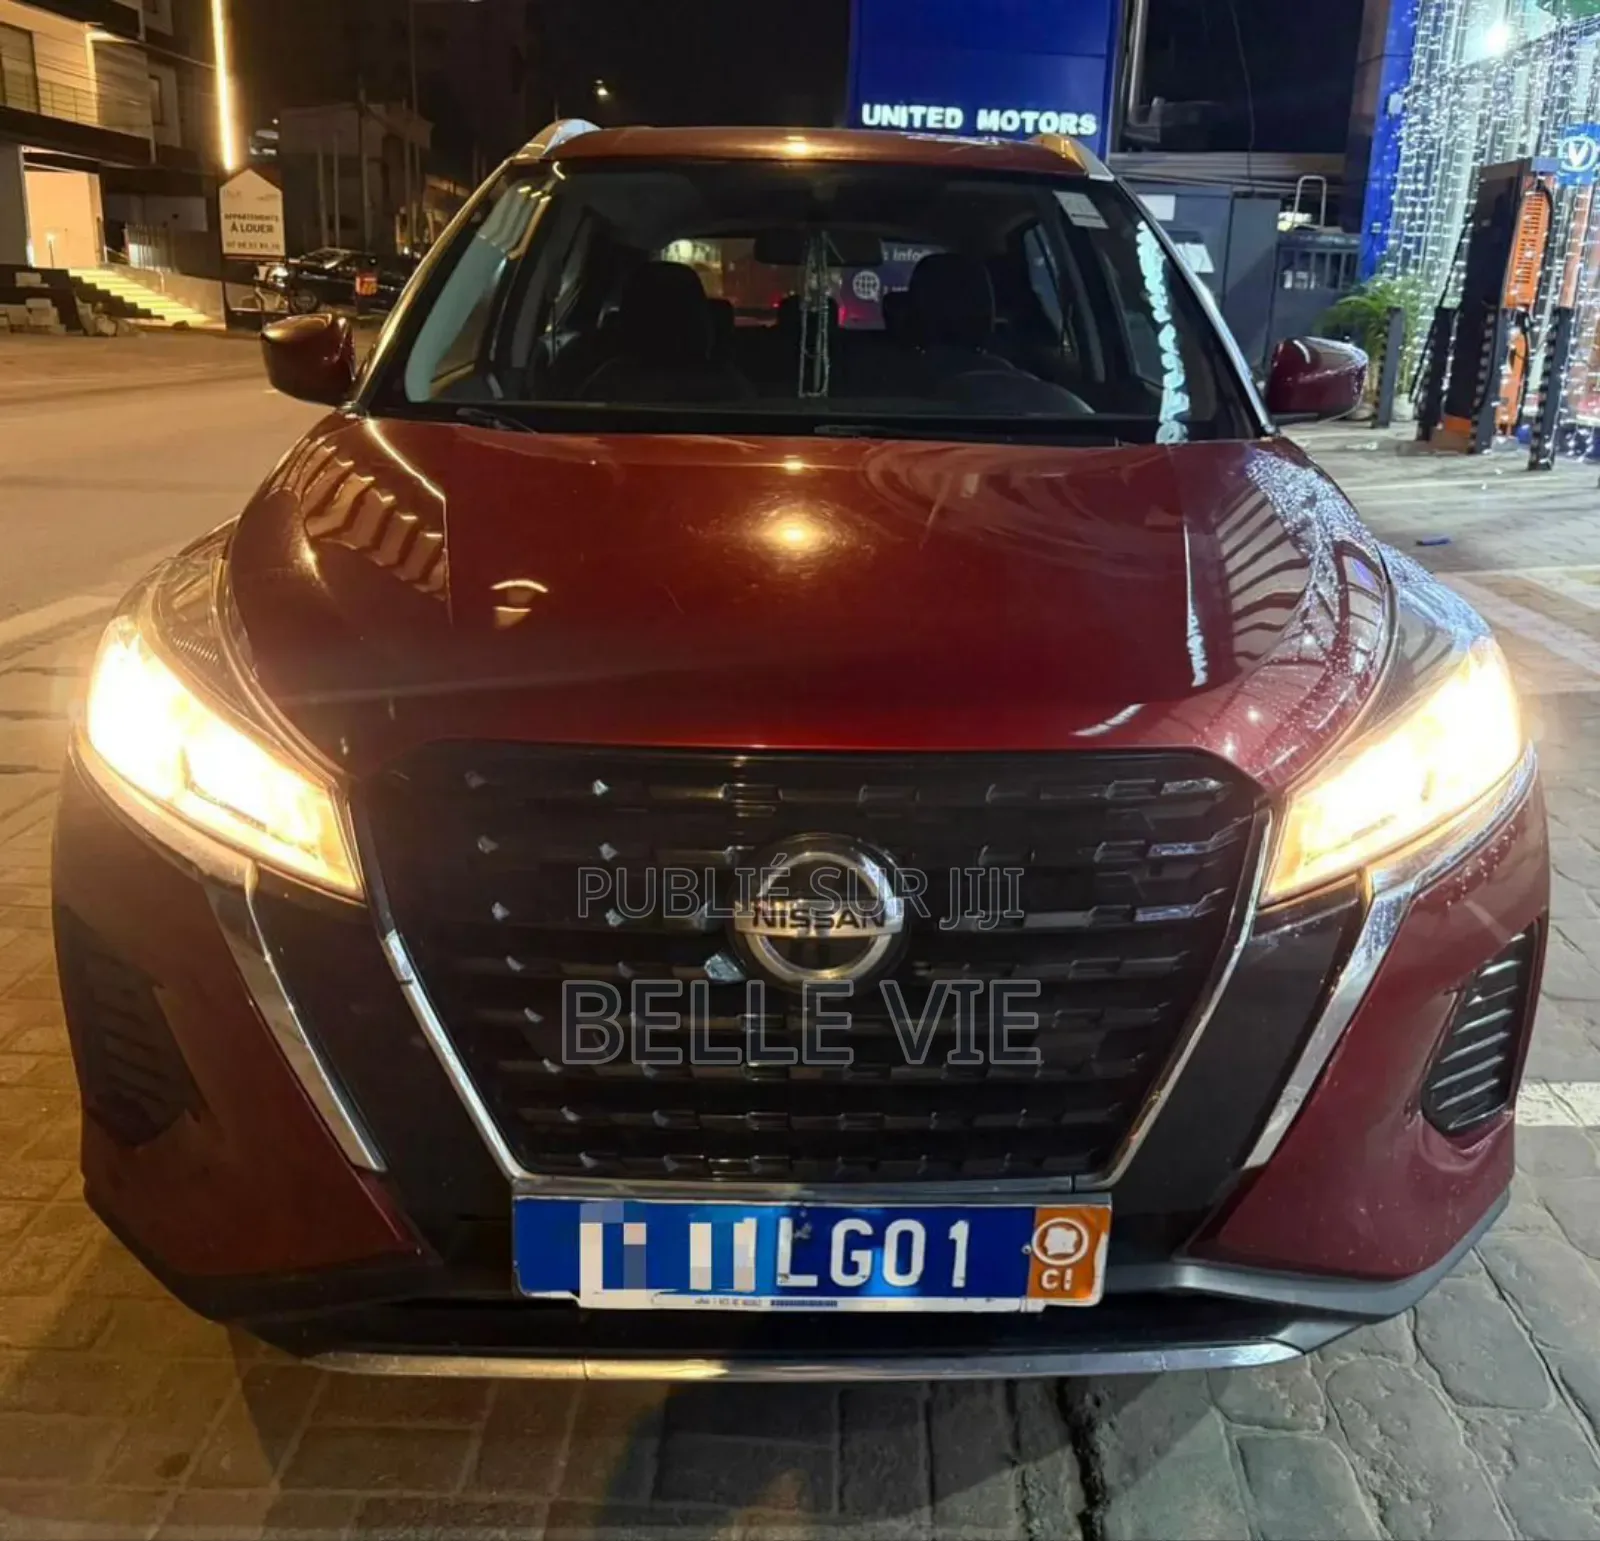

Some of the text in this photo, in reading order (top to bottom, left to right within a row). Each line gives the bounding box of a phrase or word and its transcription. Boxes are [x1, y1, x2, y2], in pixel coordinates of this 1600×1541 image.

[862, 103, 1097, 135] UNITED MOTORS
[240, 223, 274, 233] LOUER
[752, 901, 886, 930] NISSAN
[1041, 1267, 1073, 1291] CI
